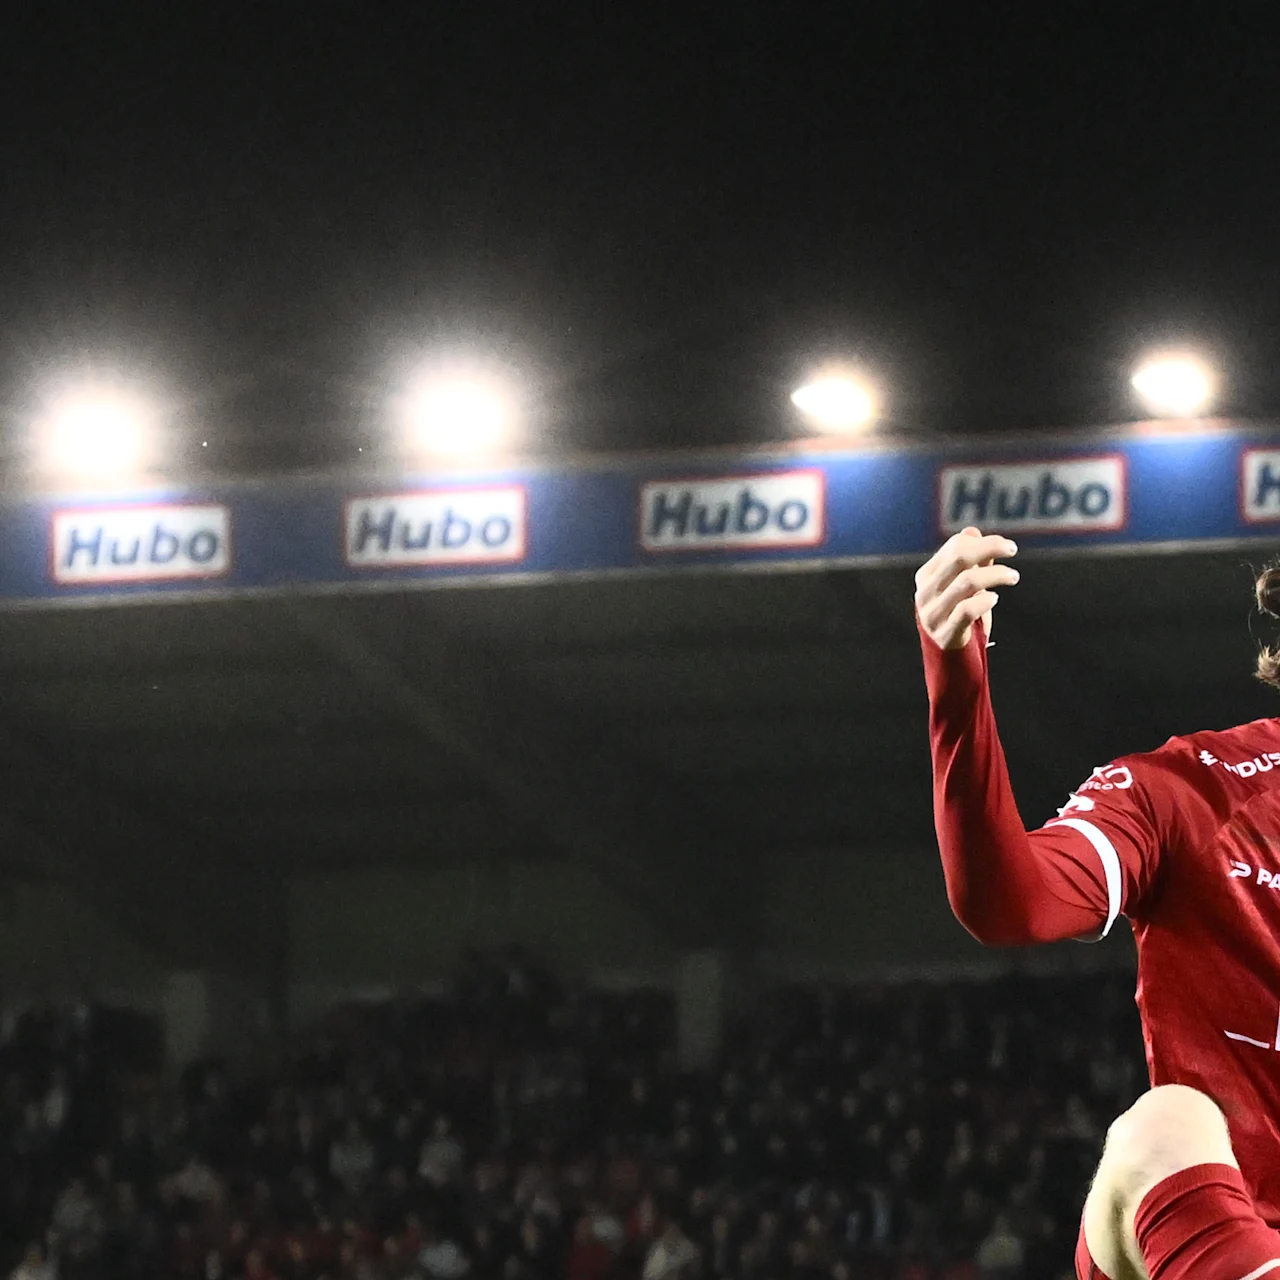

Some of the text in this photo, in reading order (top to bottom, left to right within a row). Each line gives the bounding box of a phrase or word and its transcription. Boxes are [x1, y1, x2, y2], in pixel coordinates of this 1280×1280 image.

[646, 486, 809, 539] Hubo
[949, 471, 1111, 523] Hubo
[65, 519, 219, 569] Hubo
[354, 502, 511, 553] Hubo
